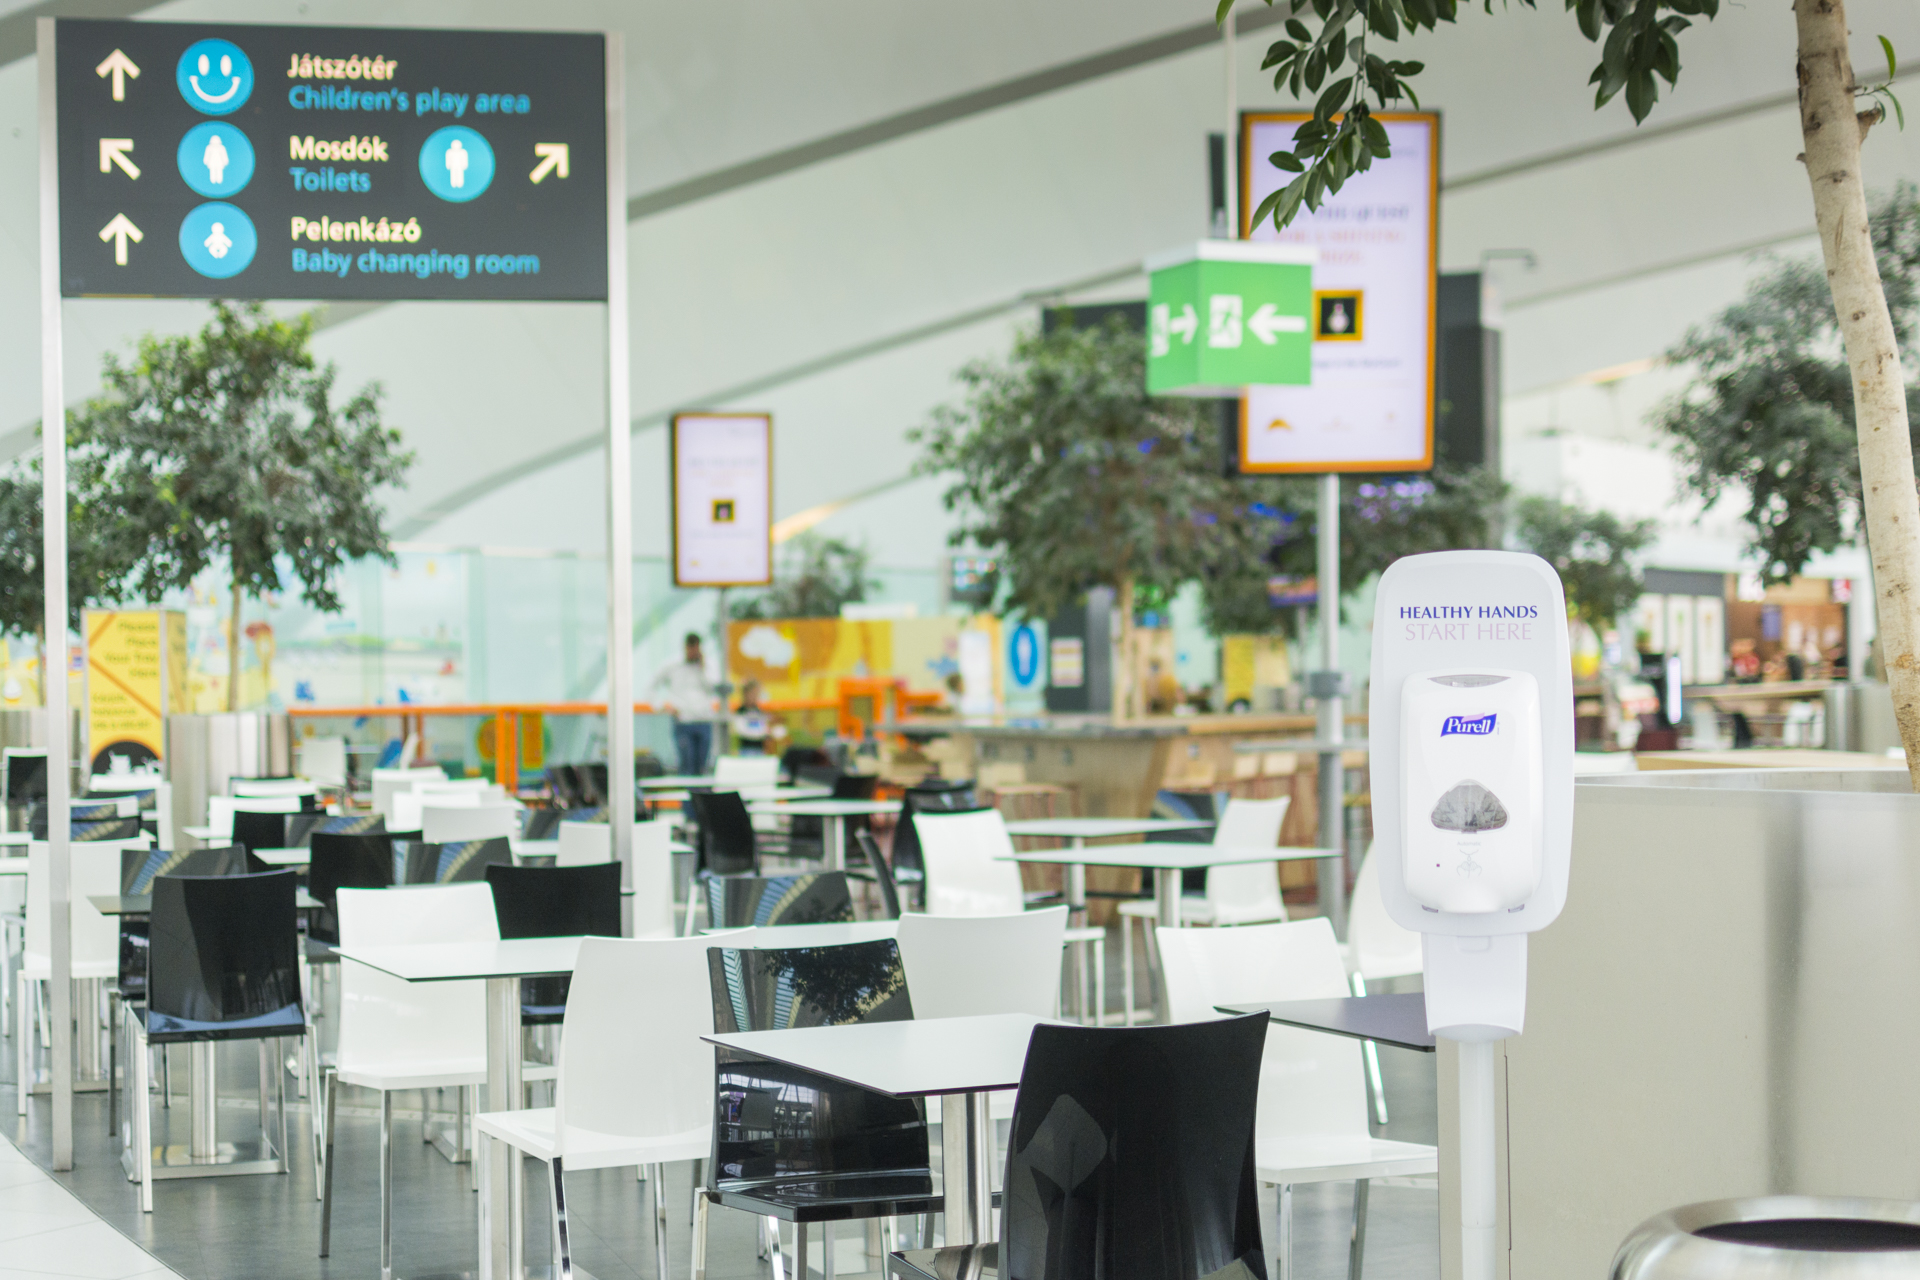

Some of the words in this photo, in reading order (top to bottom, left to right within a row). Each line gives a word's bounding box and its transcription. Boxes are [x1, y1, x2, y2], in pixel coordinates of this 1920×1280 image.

[287, 52, 398, 80] Játszótér
[288, 85, 410, 112] Children's
[416, 86, 469, 117] play
[474, 94, 531, 114] area
[289, 135, 390, 162] Mosdók
[289, 167, 372, 193] Toilets
[290, 216, 422, 243] Pelenkázó
[291, 247, 352, 277] Baby
[357, 249, 470, 280] changing
[475, 254, 541, 274] room
[1400, 606, 1473, 619] HEALTHY
[1478, 605, 1538, 619] HANDS
[1405, 624, 1469, 641] START
[1477, 623, 1532, 640] HERE
[1446, 718, 1492, 734] Purell
